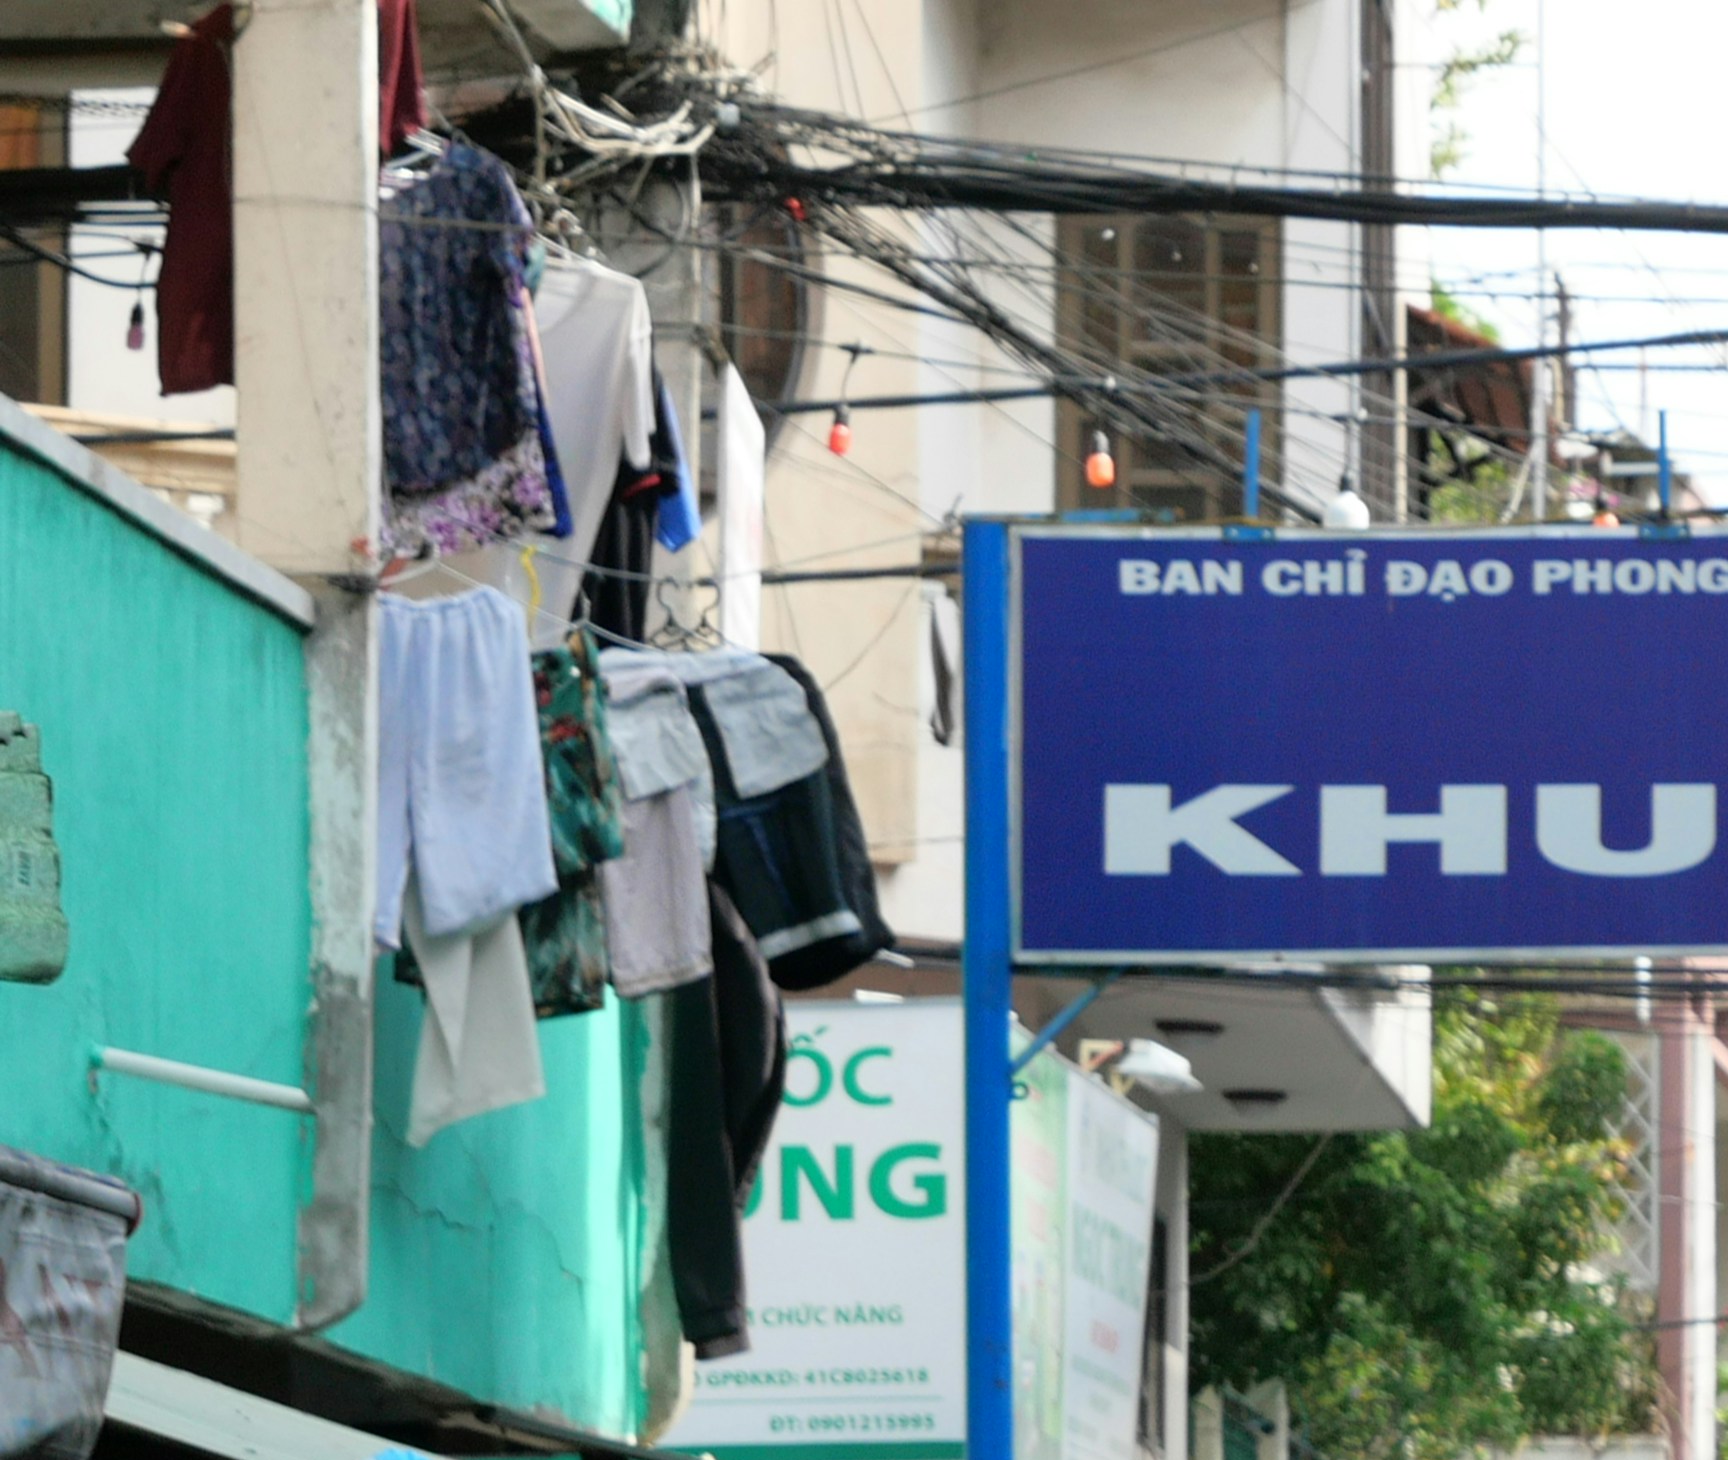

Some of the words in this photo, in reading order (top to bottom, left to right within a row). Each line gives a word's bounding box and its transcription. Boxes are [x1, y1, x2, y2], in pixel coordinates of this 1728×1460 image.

[1120, 560, 1242, 595] BAN
[1262, 549, 1366, 595] CHỈ
[1385, 560, 1513, 601] ĐẠO
[1104, 784, 1716, 876] KHU
